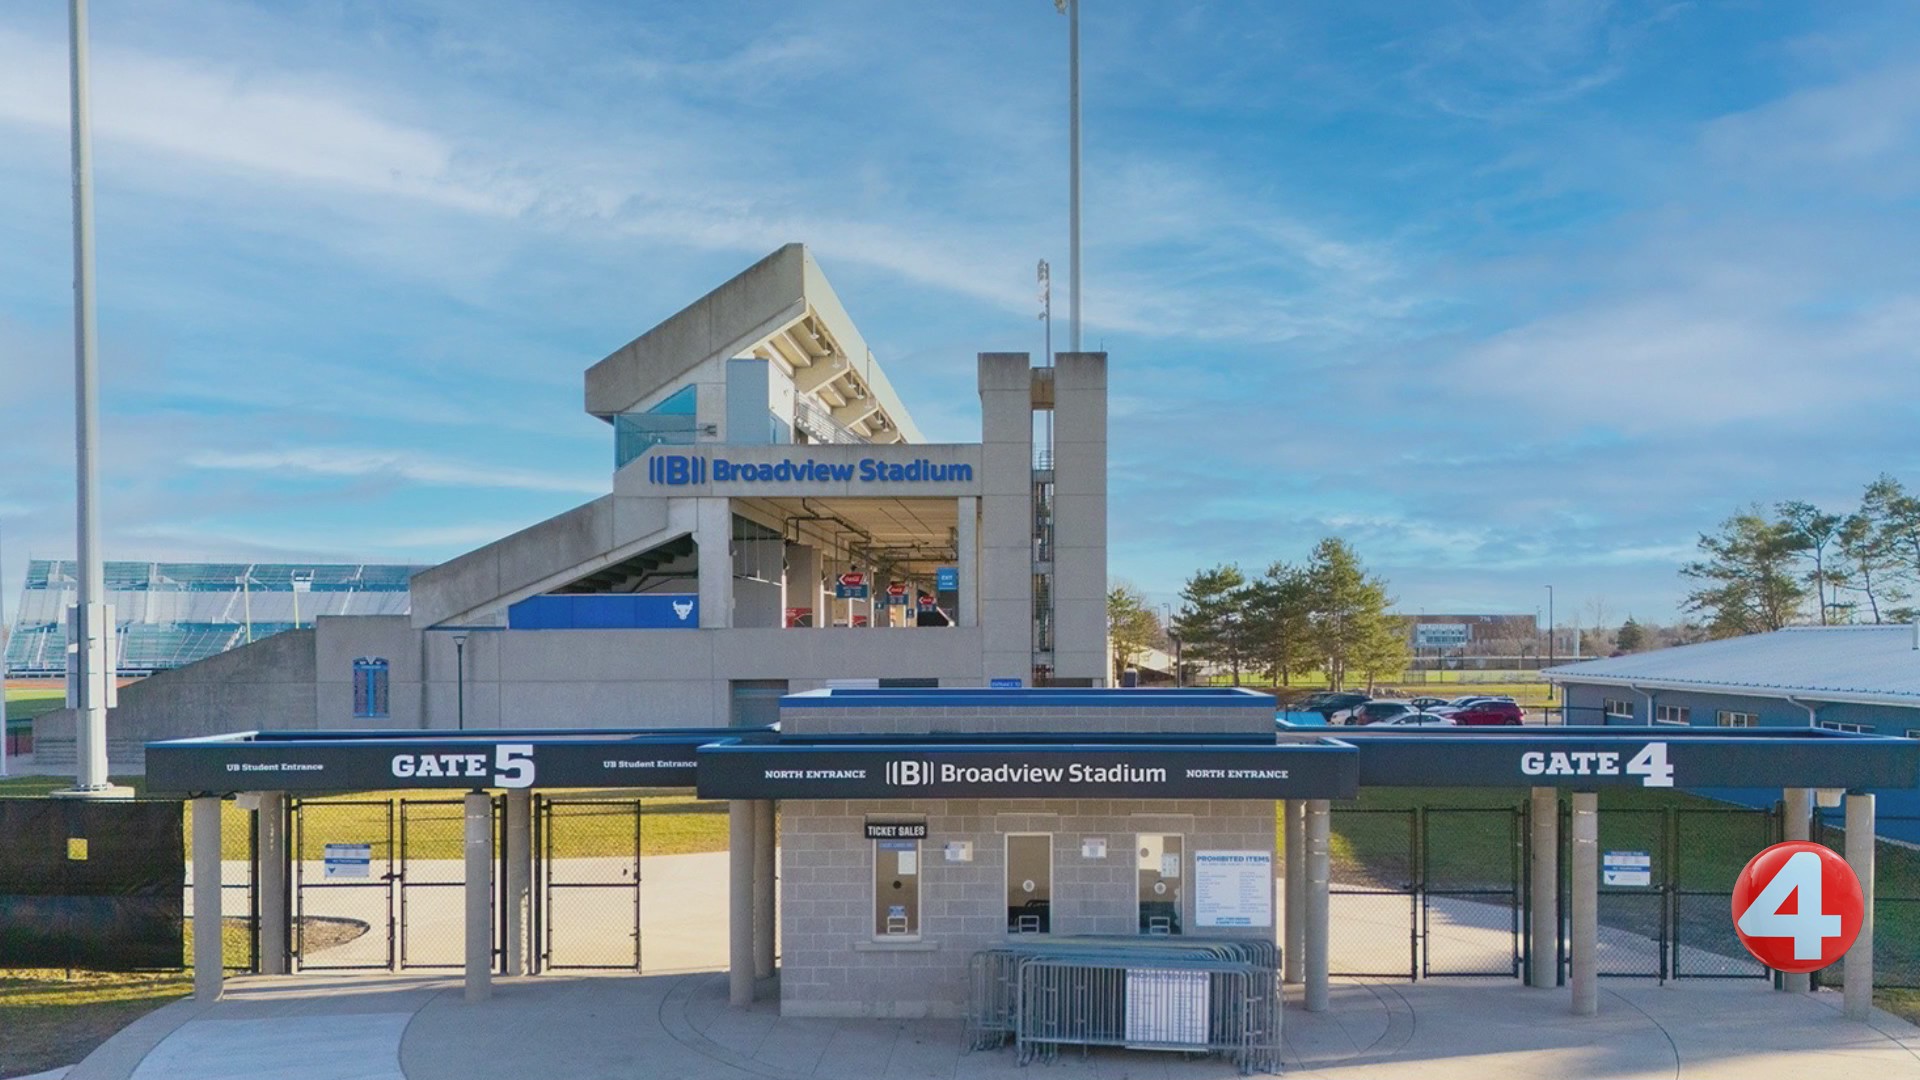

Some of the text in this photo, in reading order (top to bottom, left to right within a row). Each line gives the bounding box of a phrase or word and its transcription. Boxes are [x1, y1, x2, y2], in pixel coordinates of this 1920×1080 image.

[712, 459, 854, 481] Broadview
[858, 459, 973, 481] Stadium
[226, 763, 324, 772] UB Student Entrance
[391, 744, 535, 788] GATE 5
[603, 760, 698, 768] UB Student Entrance
[1521, 742, 1674, 787] GATE 4
[765, 770, 866, 779] NORTH ENTRANCE
[941, 763, 1064, 783] Broadview
[1068, 763, 1167, 783] Stadium
[1186, 769, 1289, 779] NORTH ENTRANCE
[867, 825, 925, 837] TICKET SALES
[1196, 855, 1270, 863] PROHIBITED ITEMS
